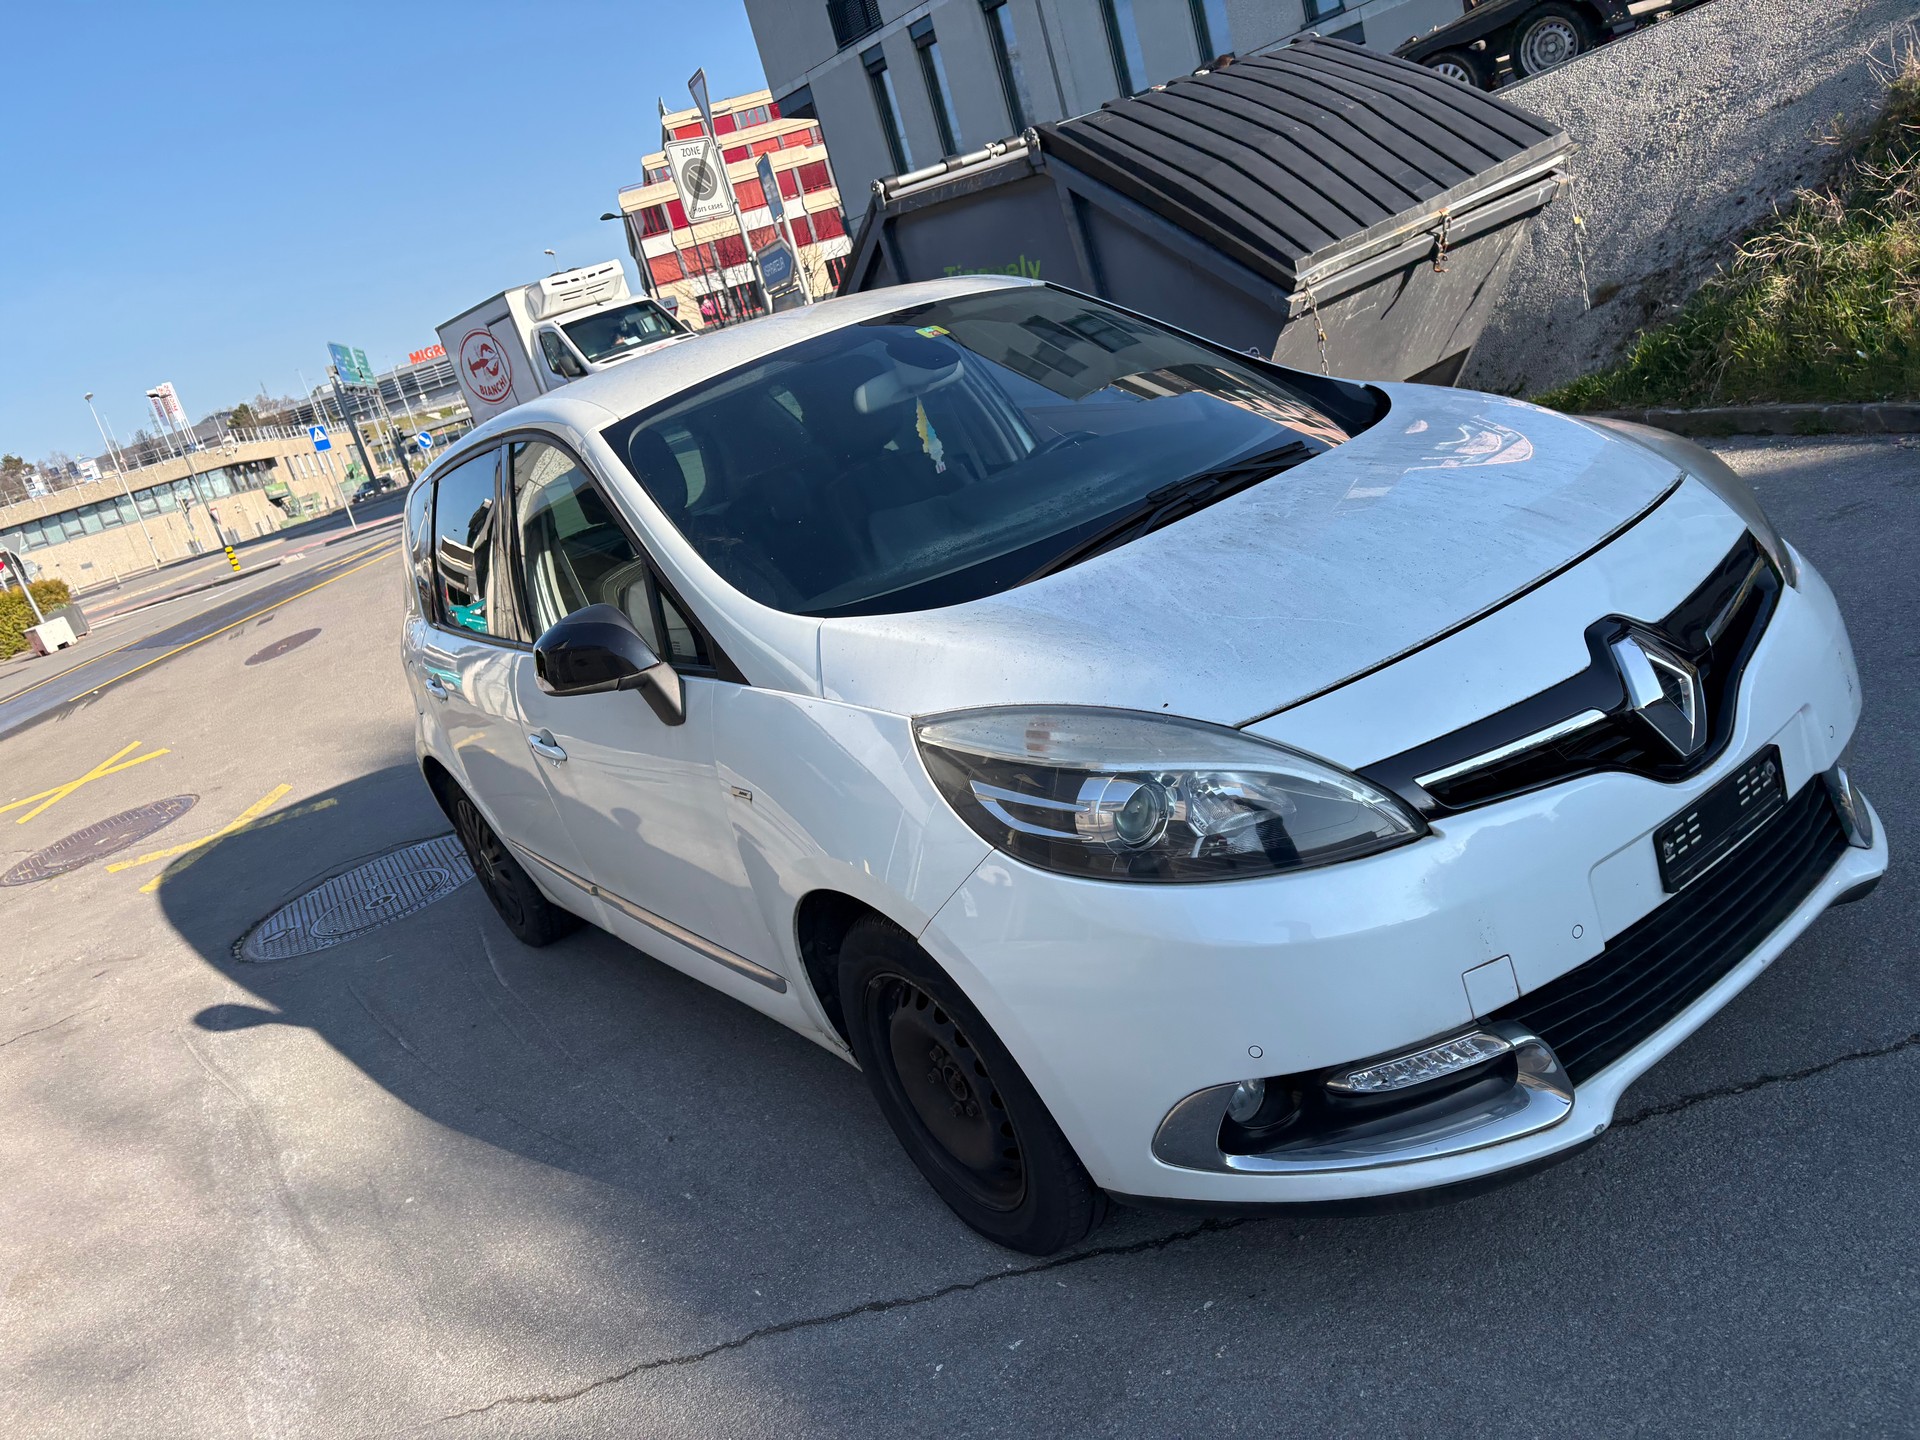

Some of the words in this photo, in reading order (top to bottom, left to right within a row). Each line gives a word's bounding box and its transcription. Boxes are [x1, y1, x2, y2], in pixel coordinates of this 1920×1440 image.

[681, 146, 701, 157] ZONE
[707, 203, 724, 212] cases
[479, 374, 508, 396] BIANCHI
